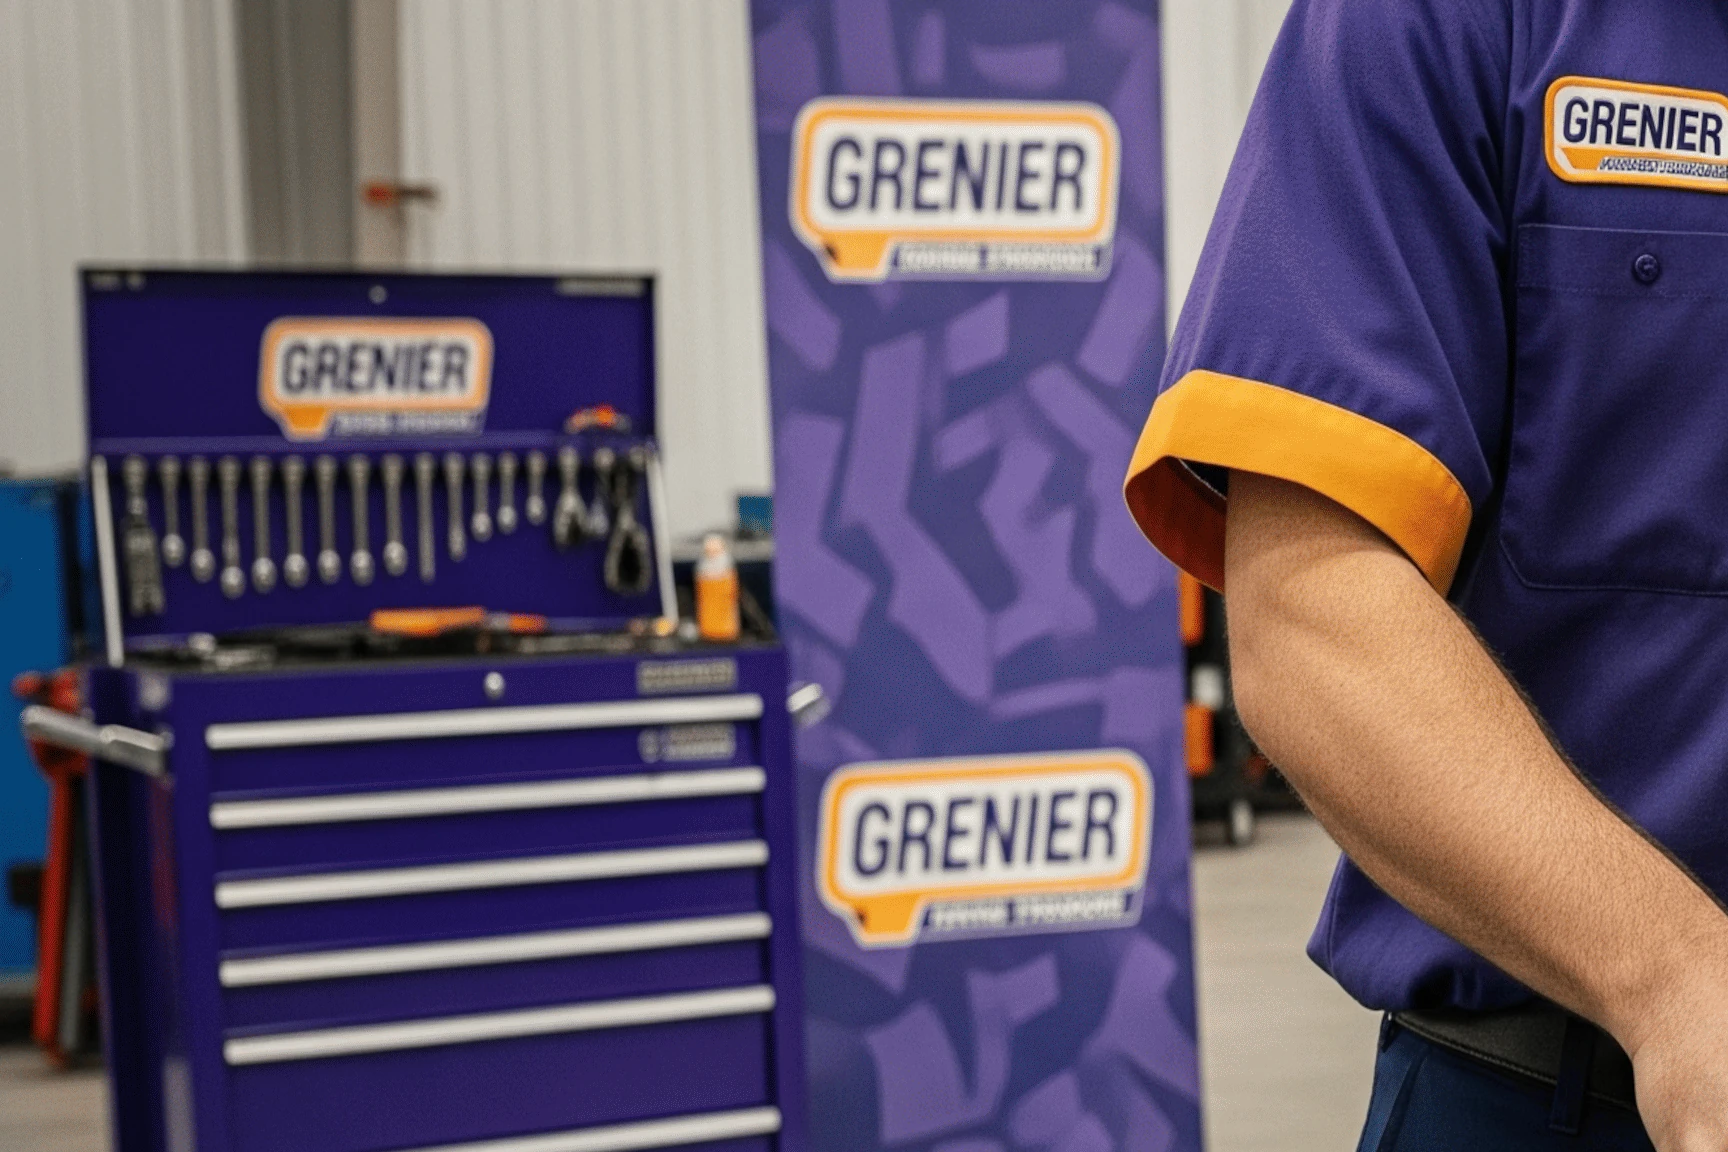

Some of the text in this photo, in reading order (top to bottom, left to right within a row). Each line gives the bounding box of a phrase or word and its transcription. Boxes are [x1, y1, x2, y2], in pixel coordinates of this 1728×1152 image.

[1563, 97, 1723, 156] GRENIER
[826, 136, 1087, 213] GRENIER
[283, 343, 469, 394] GRENIER
[854, 788, 1119, 877] GRENIER
